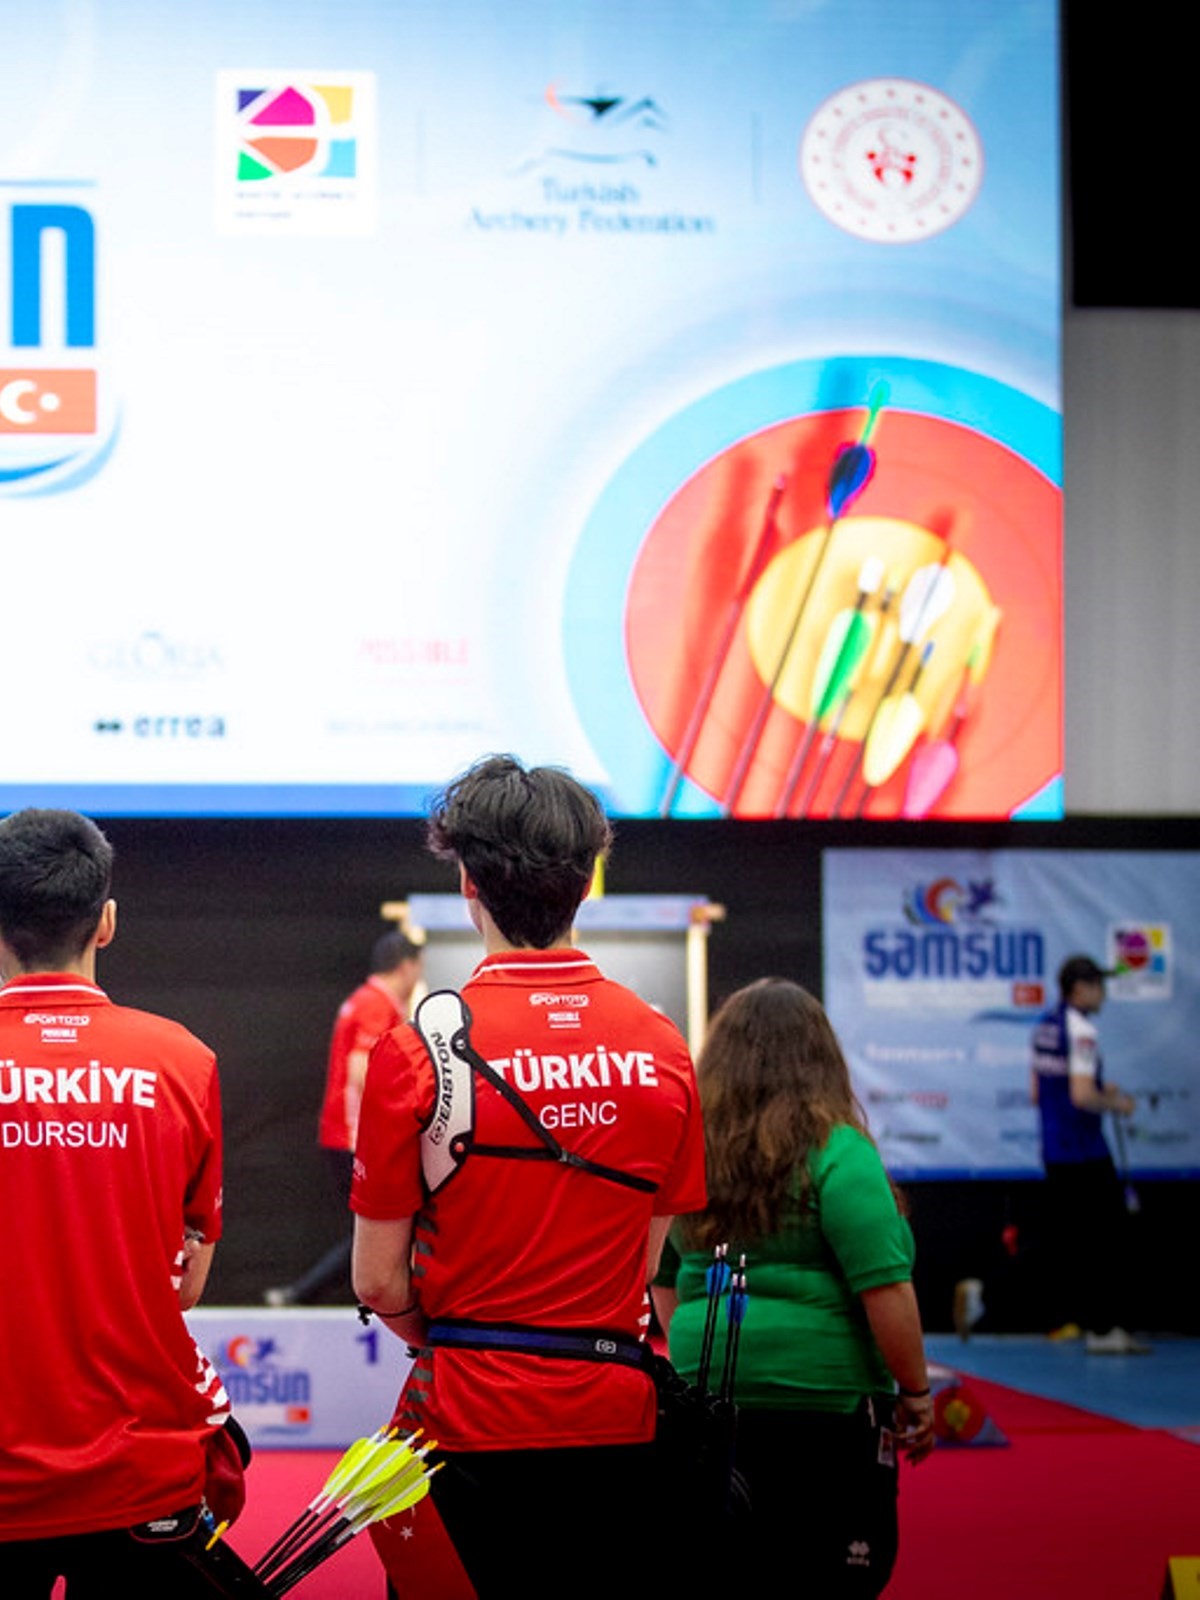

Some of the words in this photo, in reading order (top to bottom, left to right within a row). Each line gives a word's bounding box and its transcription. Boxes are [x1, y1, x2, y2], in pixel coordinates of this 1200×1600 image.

[430, 1031, 454, 1121] EASTON
[539, 1100, 618, 1129] GENC
[2, 1121, 128, 1148] DURSUN
[357, 1331, 378, 1364] 1
